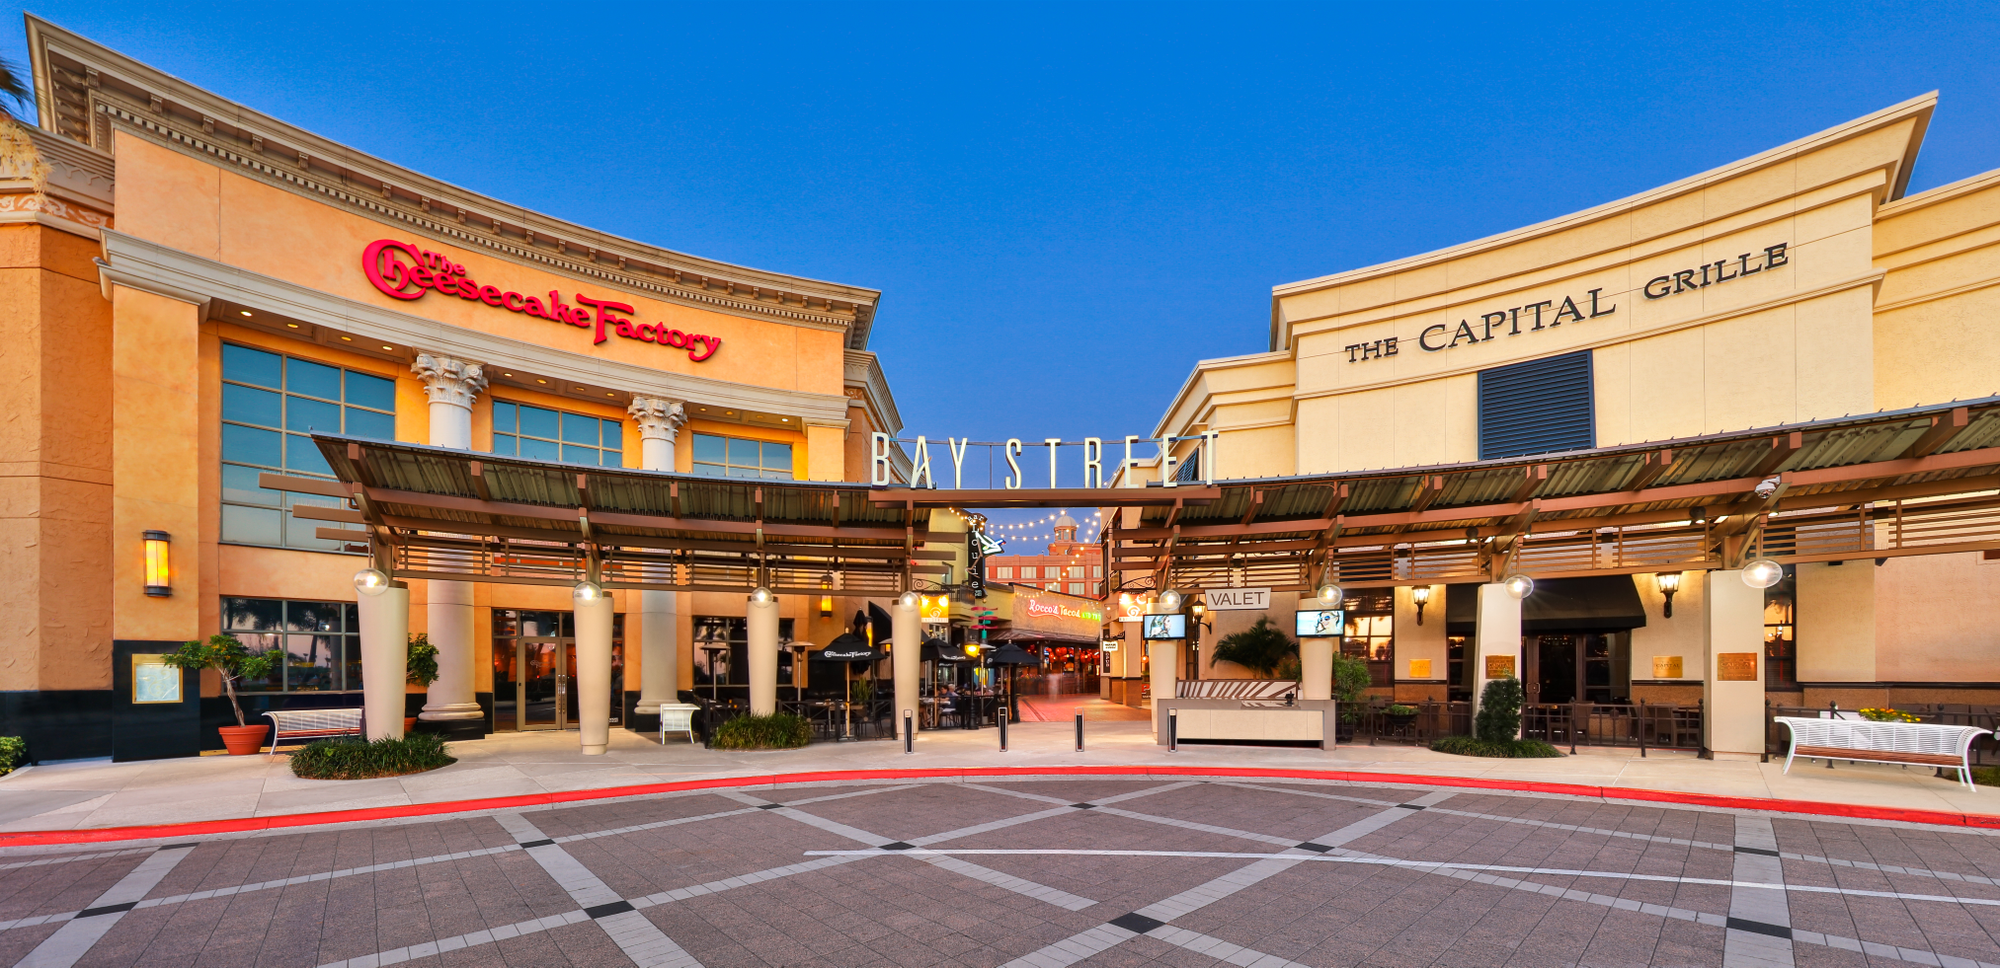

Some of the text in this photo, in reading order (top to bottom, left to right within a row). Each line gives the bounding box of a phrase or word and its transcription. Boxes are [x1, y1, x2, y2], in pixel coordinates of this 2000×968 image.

[422, 249, 466, 276] The
[362, 239, 722, 362] Cheesecake Factory
[1344, 242, 1789, 363] THE CAPITAL GRILLE
[871, 430, 1220, 490] BAY STREET
[971, 524, 980, 589] Louie
[1028, 598, 1060, 615] Rocco's
[1059, 604, 1081, 618] Tacos
[1210, 591, 1265, 606] VALET
